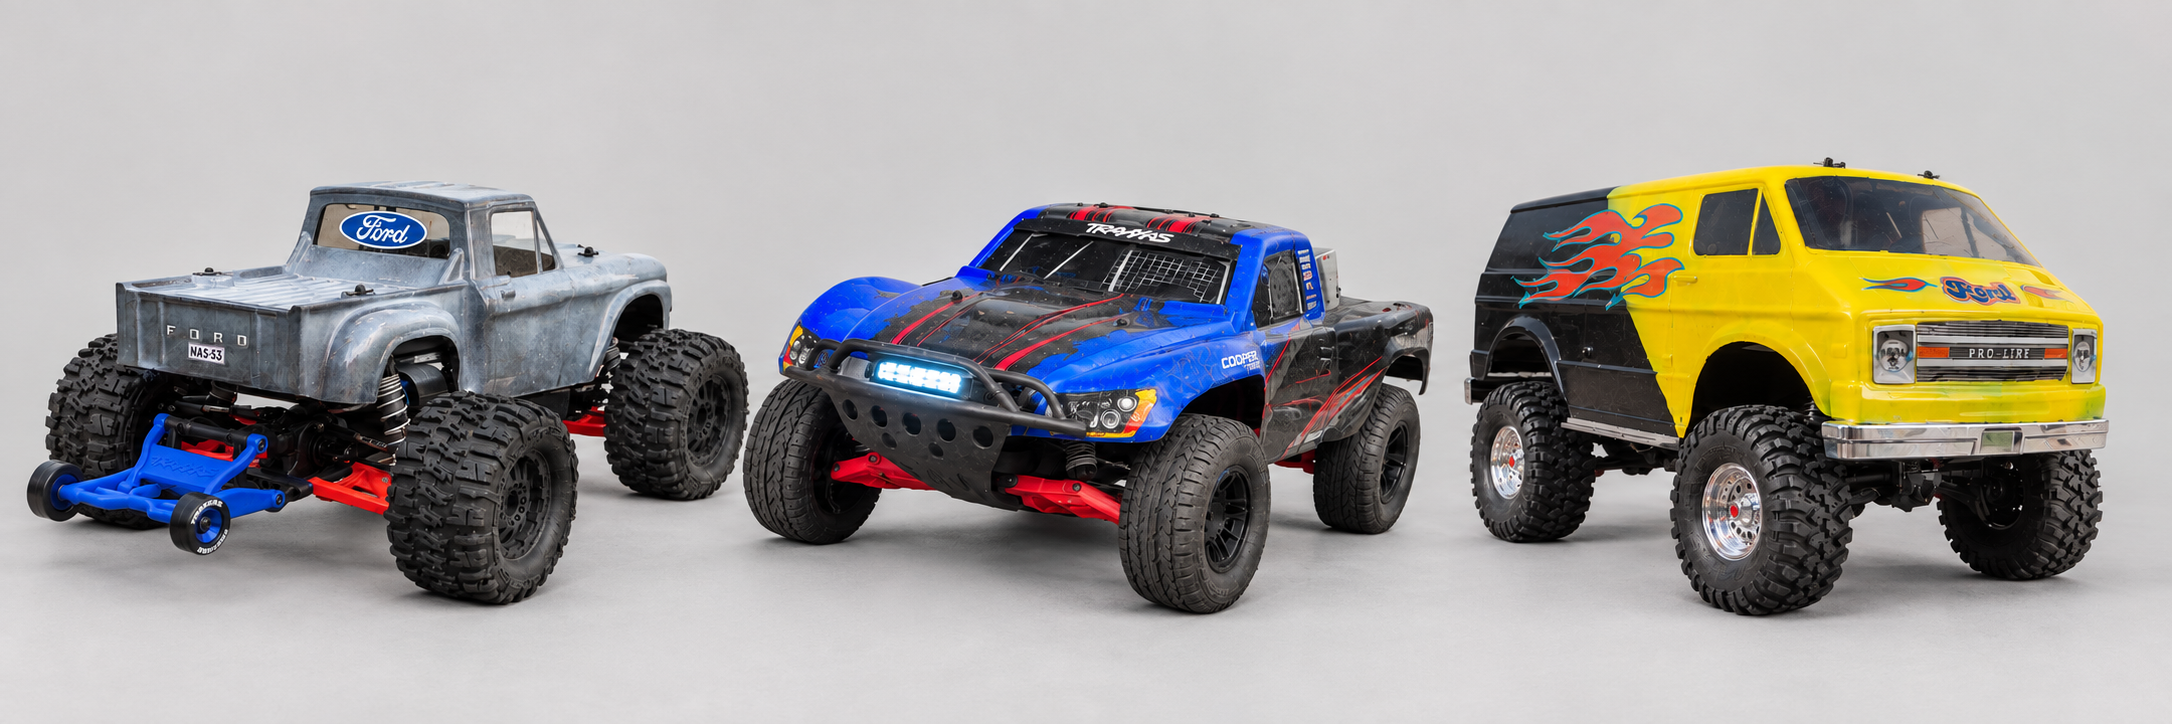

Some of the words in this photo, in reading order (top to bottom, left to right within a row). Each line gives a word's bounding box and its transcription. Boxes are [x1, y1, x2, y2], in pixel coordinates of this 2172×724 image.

[356, 214, 411, 244] Ford
[1085, 223, 1175, 243] TRAXXAS
[166, 324, 248, 347] FORD
[1221, 350, 1259, 370] COOPER
